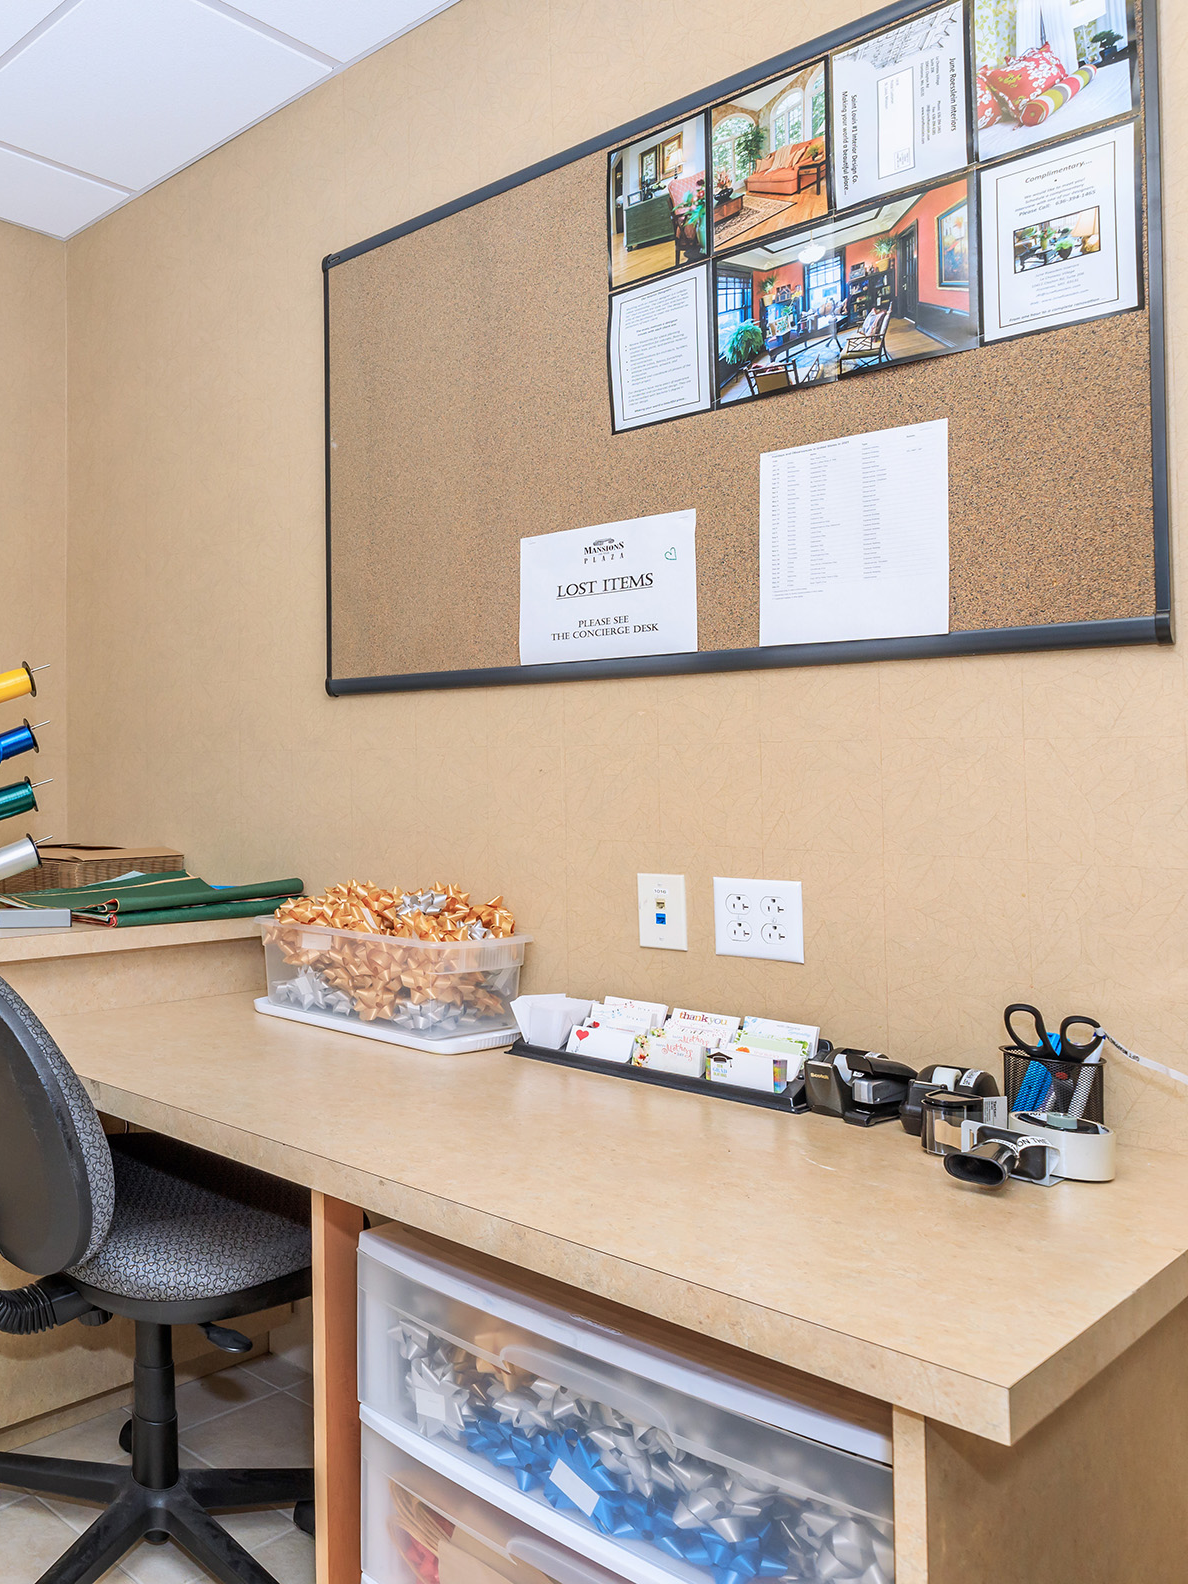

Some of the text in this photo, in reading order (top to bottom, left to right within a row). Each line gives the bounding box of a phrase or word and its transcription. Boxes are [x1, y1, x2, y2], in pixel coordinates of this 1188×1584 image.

[949, 57, 957, 73] June
[950, 104, 958, 132] Interiors
[841, 148, 849, 174] beautiful
[583, 541, 625, 556] MANSIONS
[583, 552, 625, 565] PLAZA
[557, 572, 654, 598] LOST ITEMS
[578, 615, 630, 629] PLEASE SEE
[551, 623, 660, 642] THE CONCIERGE DESK
[679, 1011, 728, 1025] thank you
[810, 1072, 829, 1080] Scotch
[1016, 1137, 1031, 1148] ON
